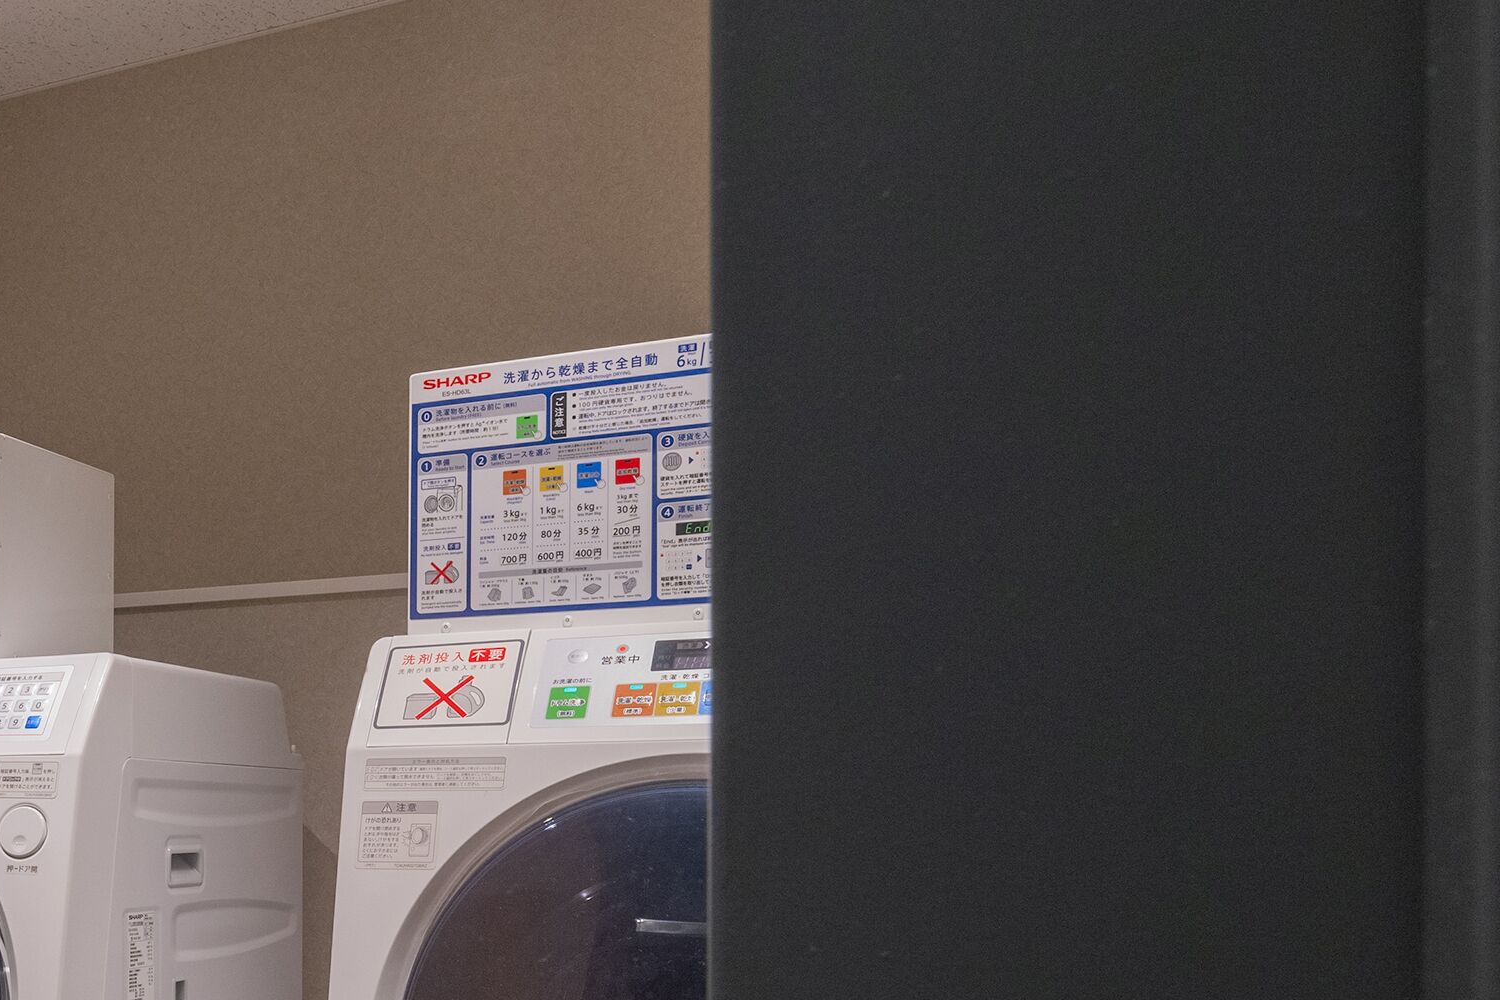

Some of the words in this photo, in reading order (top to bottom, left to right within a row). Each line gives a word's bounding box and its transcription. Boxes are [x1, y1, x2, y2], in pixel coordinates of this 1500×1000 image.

[676, 355, 697, 368] 6kg
[503, 353, 658, 384] 洗濯から乾燥まで全自動
[423, 372, 491, 390] SHARP
[442, 389, 472, 397] ES-HD63L
[436, 403, 501, 416] 洗濯物を入れる前に
[491, 447, 551, 460] 運転コースを選ぶ
[540, 506, 556, 515] 1kg
[577, 503, 595, 512] 6kg
[617, 505, 638, 514] 30分
[678, 503, 710, 512] 運転終了
[503, 510, 520, 519] 3kg
[578, 526, 600, 535] 35分
[613, 526, 641, 536] 200円
[685, 523, 710, 534] End
[502, 532, 527, 541] 120分
[541, 530, 562, 539] 80分
[423, 544, 446, 552] 洗剤投入
[575, 548, 602, 557] 400円
[501, 553, 527, 564] 700円
[537, 551, 564, 561] 600円
[402, 652, 464, 666] 洗剤投入
[472, 649, 504, 661] 不要
[602, 654, 640, 665] 営業中
[398, 663, 505, 675] 洗剤が自動で投入されます
[552, 677, 592, 685] お洗濯の前に
[661, 673, 699, 681] 洗濯・乾燥
[7, 686, 14, 694] 2
[24, 686, 30, 694] 3
[1, 702, 7, 710] 5
[18, 702, 24, 710] 6
[35, 701, 42, 709] 0
[13, 718, 19, 726] 9
[396, 803, 417, 812] 注意
